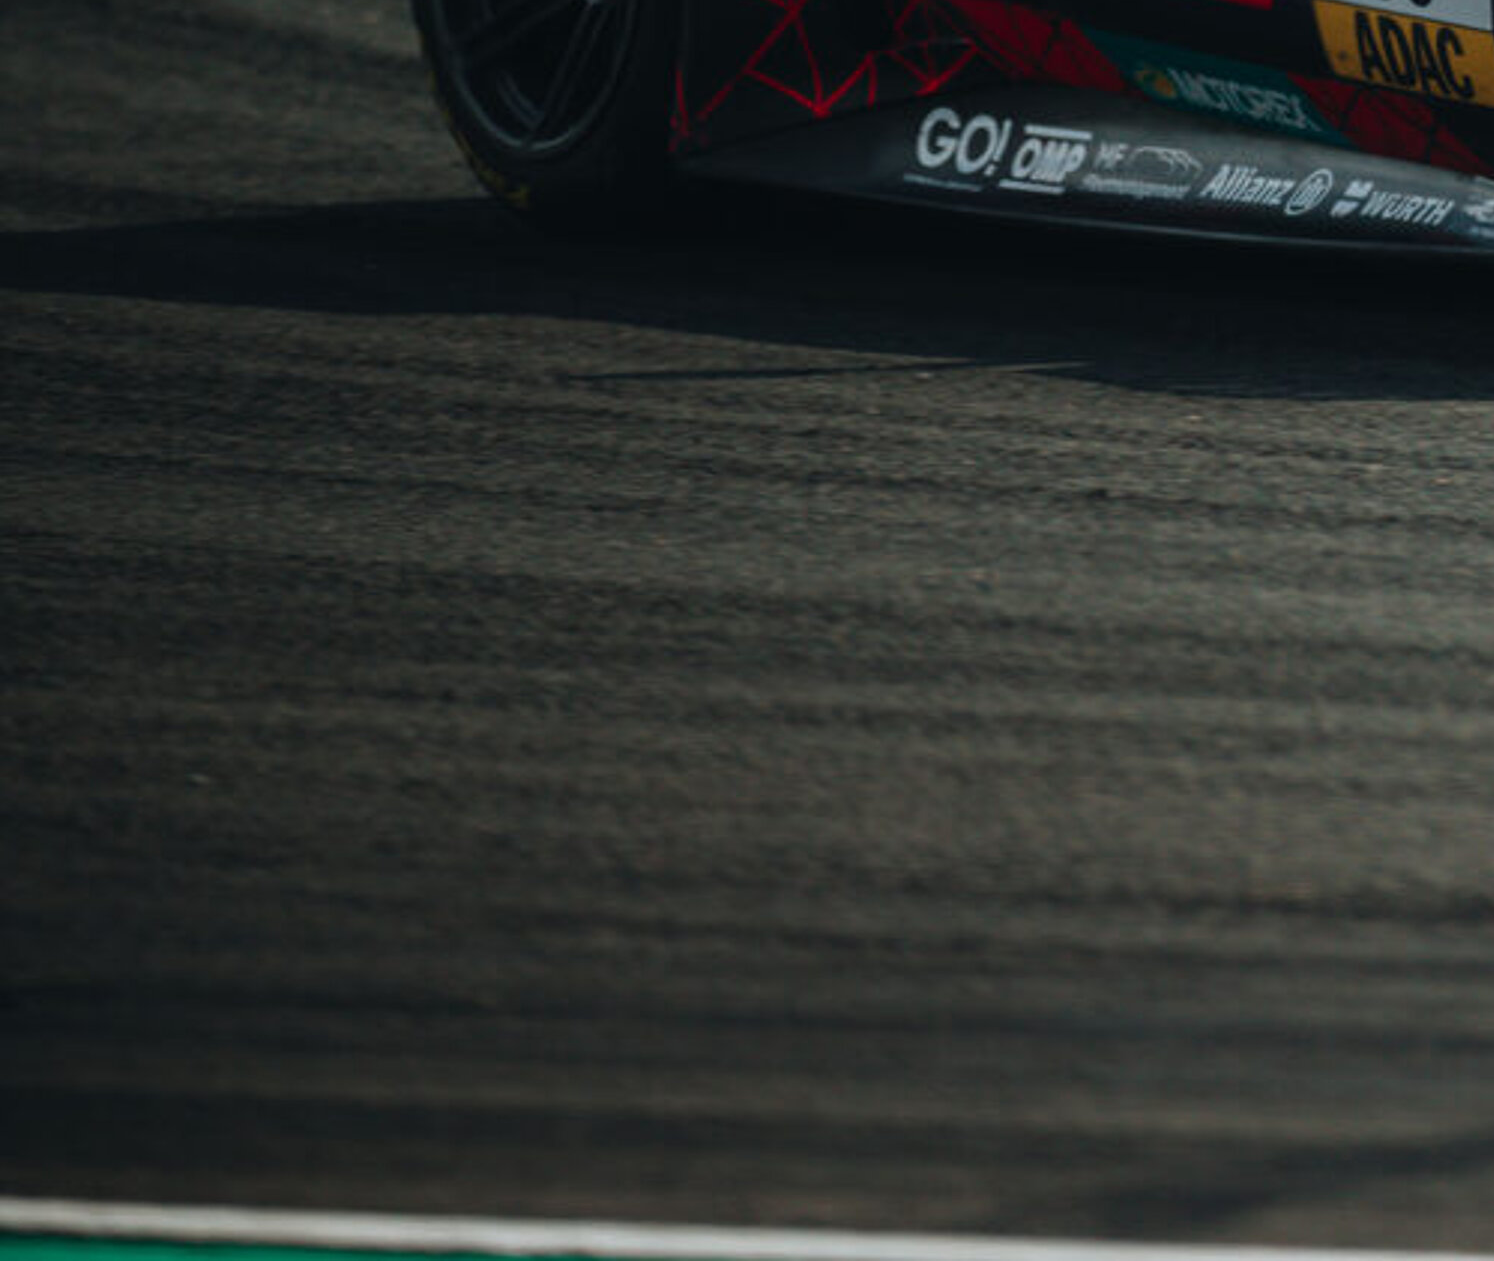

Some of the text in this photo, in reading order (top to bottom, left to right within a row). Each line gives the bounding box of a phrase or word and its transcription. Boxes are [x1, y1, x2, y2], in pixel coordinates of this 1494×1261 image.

[1355, 11, 1475, 98] ADAC
[915, 106, 1013, 177] GO!
[1010, 138, 1087, 183] OMP
[1200, 163, 1294, 206] Allianz
